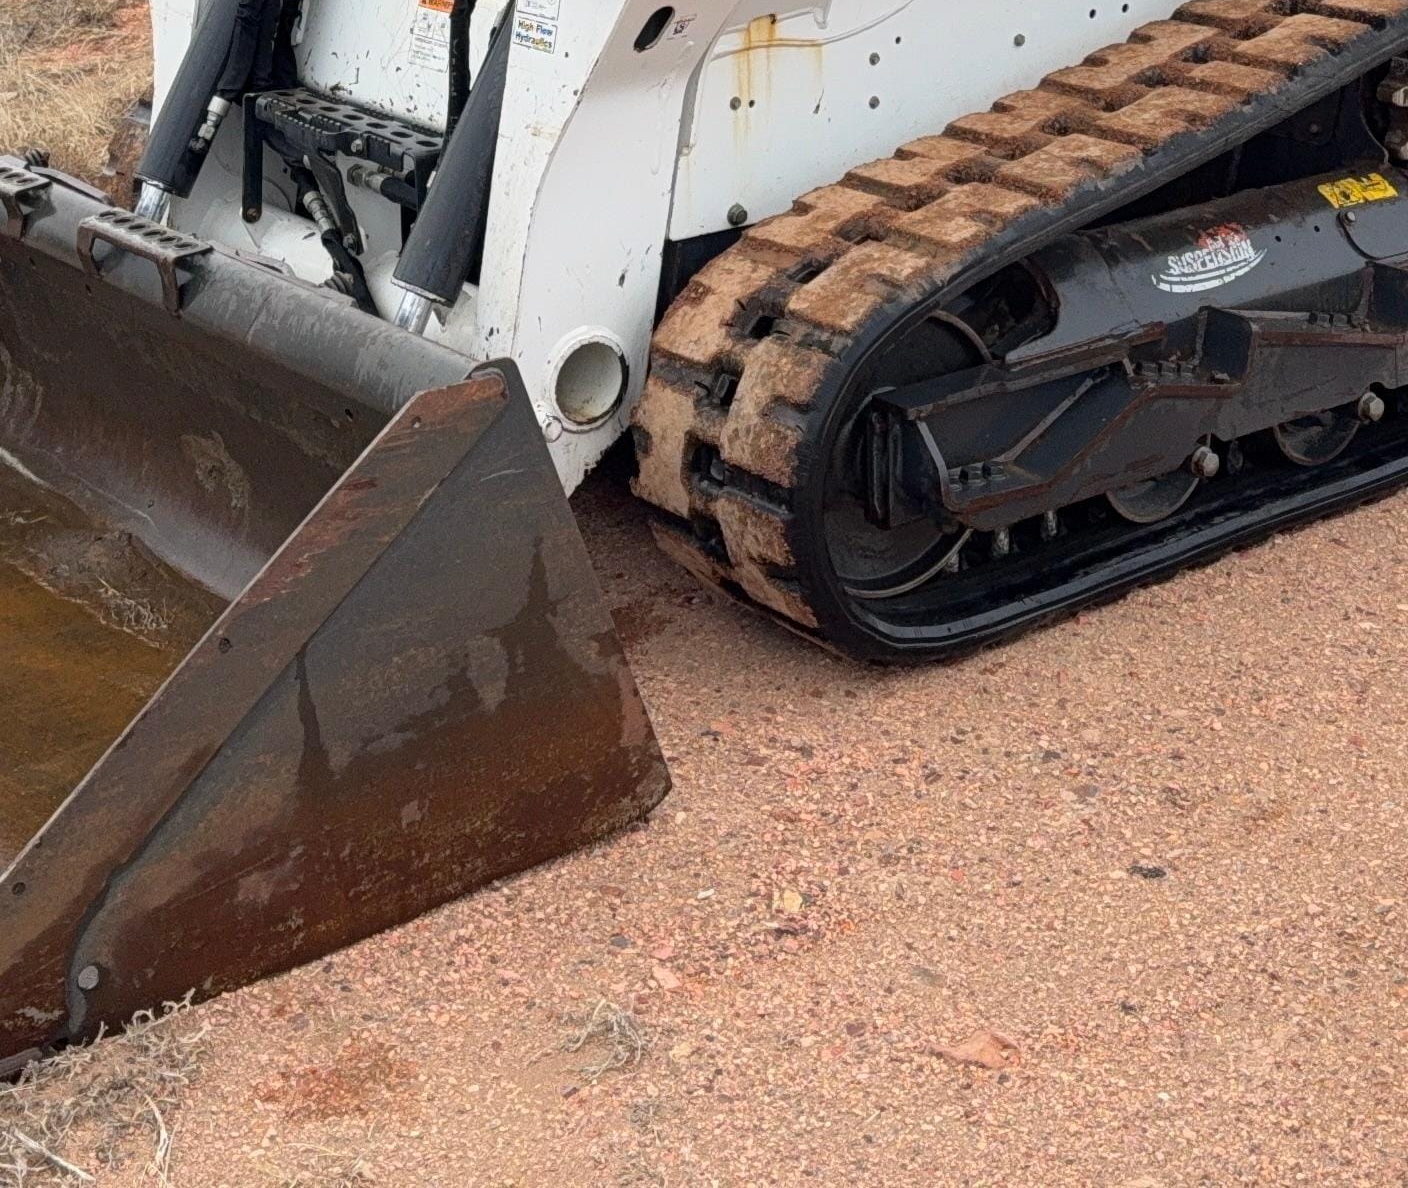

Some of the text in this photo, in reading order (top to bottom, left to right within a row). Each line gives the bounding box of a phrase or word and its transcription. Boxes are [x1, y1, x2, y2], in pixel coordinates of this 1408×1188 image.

[518, 19, 553, 36] High Flow
[515, 32, 553, 48] Hydraulics
